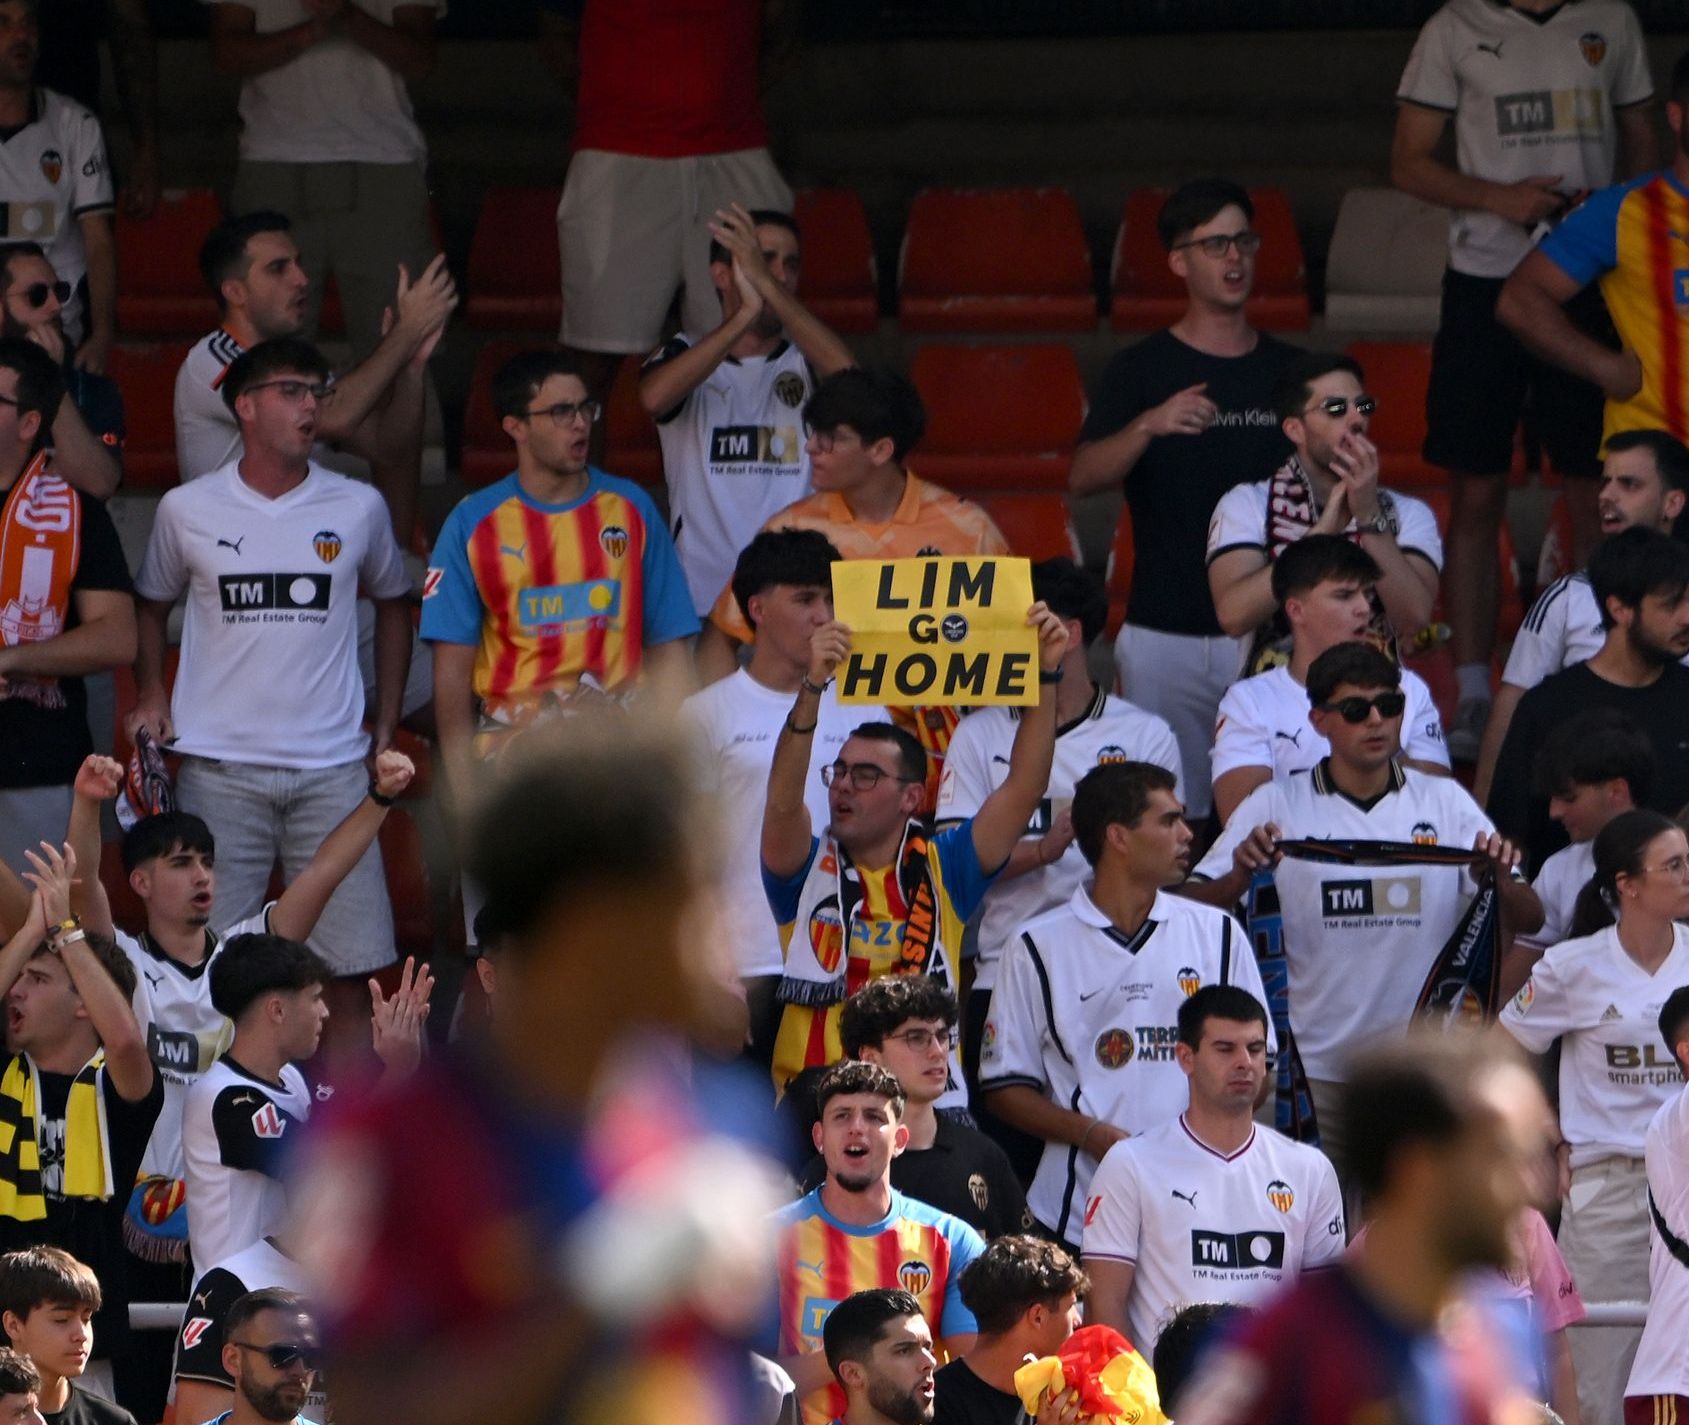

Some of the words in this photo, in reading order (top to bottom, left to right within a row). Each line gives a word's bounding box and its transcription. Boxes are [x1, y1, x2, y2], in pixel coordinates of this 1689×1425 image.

[1507, 102, 1545, 125] TM
[718, 436, 749, 457] TM
[726, 466, 745, 476] Real
[748, 466, 774, 477] Estate
[225, 582, 264, 605] TM
[875, 560, 997, 612] LIM
[527, 596, 563, 617] TM
[240, 612, 260, 624] Real
[262, 612, 295, 624] Estate
[298, 613, 329, 627] Group
[842, 652, 1030, 698] HOME
[1328, 887, 1364, 910] TM
[1324, 919, 1338, 930] TM
[1341, 919, 1359, 930] Real
[1364, 918, 1394, 929] Estate
[1396, 917, 1422, 930] Group
[1452, 888, 1493, 969] VALENCIA
[1604, 1043, 1677, 1070] BL
[1198, 1239, 1228, 1263] TM
[1192, 1270, 1208, 1280] TM
[1210, 1270, 1229, 1281] Real
[1231, 1271, 1259, 1282] Estate
[1261, 1271, 1282, 1283] Group
